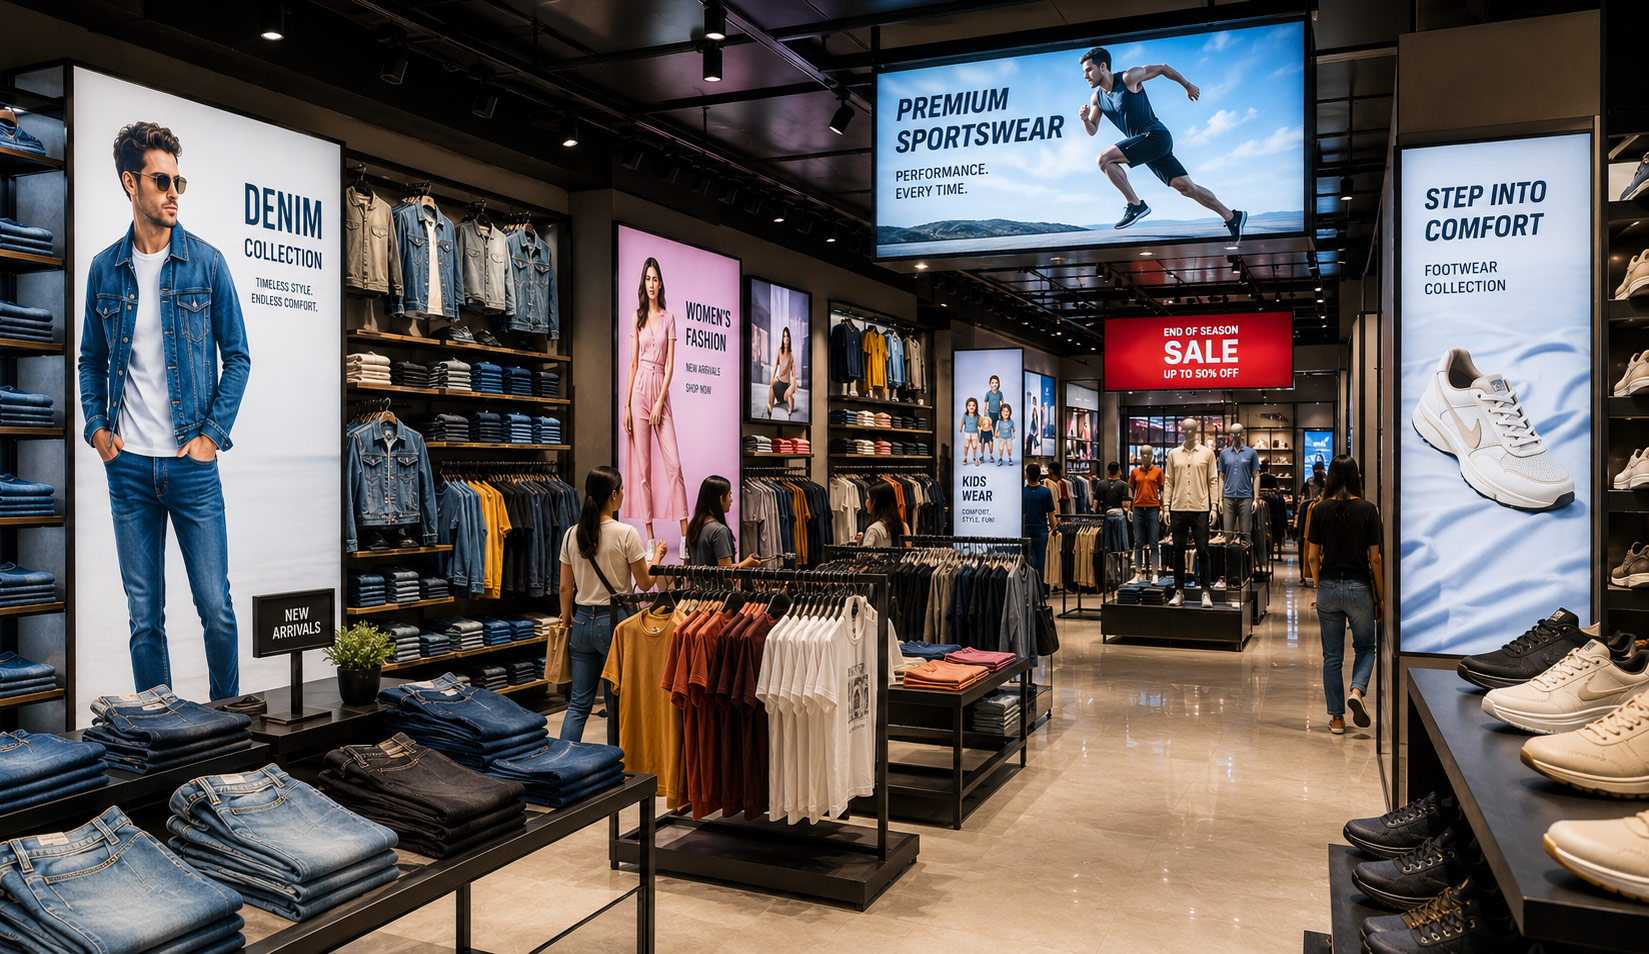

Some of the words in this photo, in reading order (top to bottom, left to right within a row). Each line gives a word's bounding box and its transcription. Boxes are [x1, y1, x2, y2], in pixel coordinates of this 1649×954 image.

[896, 87, 1009, 122] PREMIUM
[895, 115, 1065, 153] SPORTSWEAR
[896, 163, 989, 182] PERFORMANCE.
[896, 185, 932, 200] EVERY
[936, 182, 968, 196] TIME.
[1424, 184, 1484, 210] STEP
[1490, 180, 1547, 206] INTO
[245, 182, 322, 240] DENIM
[1425, 212, 1544, 242] COMFORT
[244, 238, 322, 270] COLLECTION
[1425, 261, 1498, 277] FOOTWEAR
[255, 277, 290, 292] TIMELESS
[290, 282, 313, 296] STYLE.
[1424, 279, 1506, 295] COLLECTION
[251, 293, 283, 307] ENDLESS
[284, 297, 318, 312] COMFORT.
[685, 300, 731, 328] WOMEN'S
[685, 327, 727, 352] FASHION
[1164, 327, 1183, 337] END
[1185, 326, 1198, 336] OF
[1200, 325, 1239, 336] SEASON
[1164, 338, 1239, 365] SALE
[685, 362, 698, 373] NEW
[1164, 369, 1177, 379] UP
[1180, 369, 1192, 379] TO
[1195, 368, 1217, 378] 50%
[1219, 368, 1239, 378] OFF
[685, 382, 699, 393] SHOP
[962, 475, 987, 487] KIDS
[962, 490, 993, 502] WEAR
[285, 606, 309, 622] NEW
[272, 621, 321, 640] ARRIVALS
